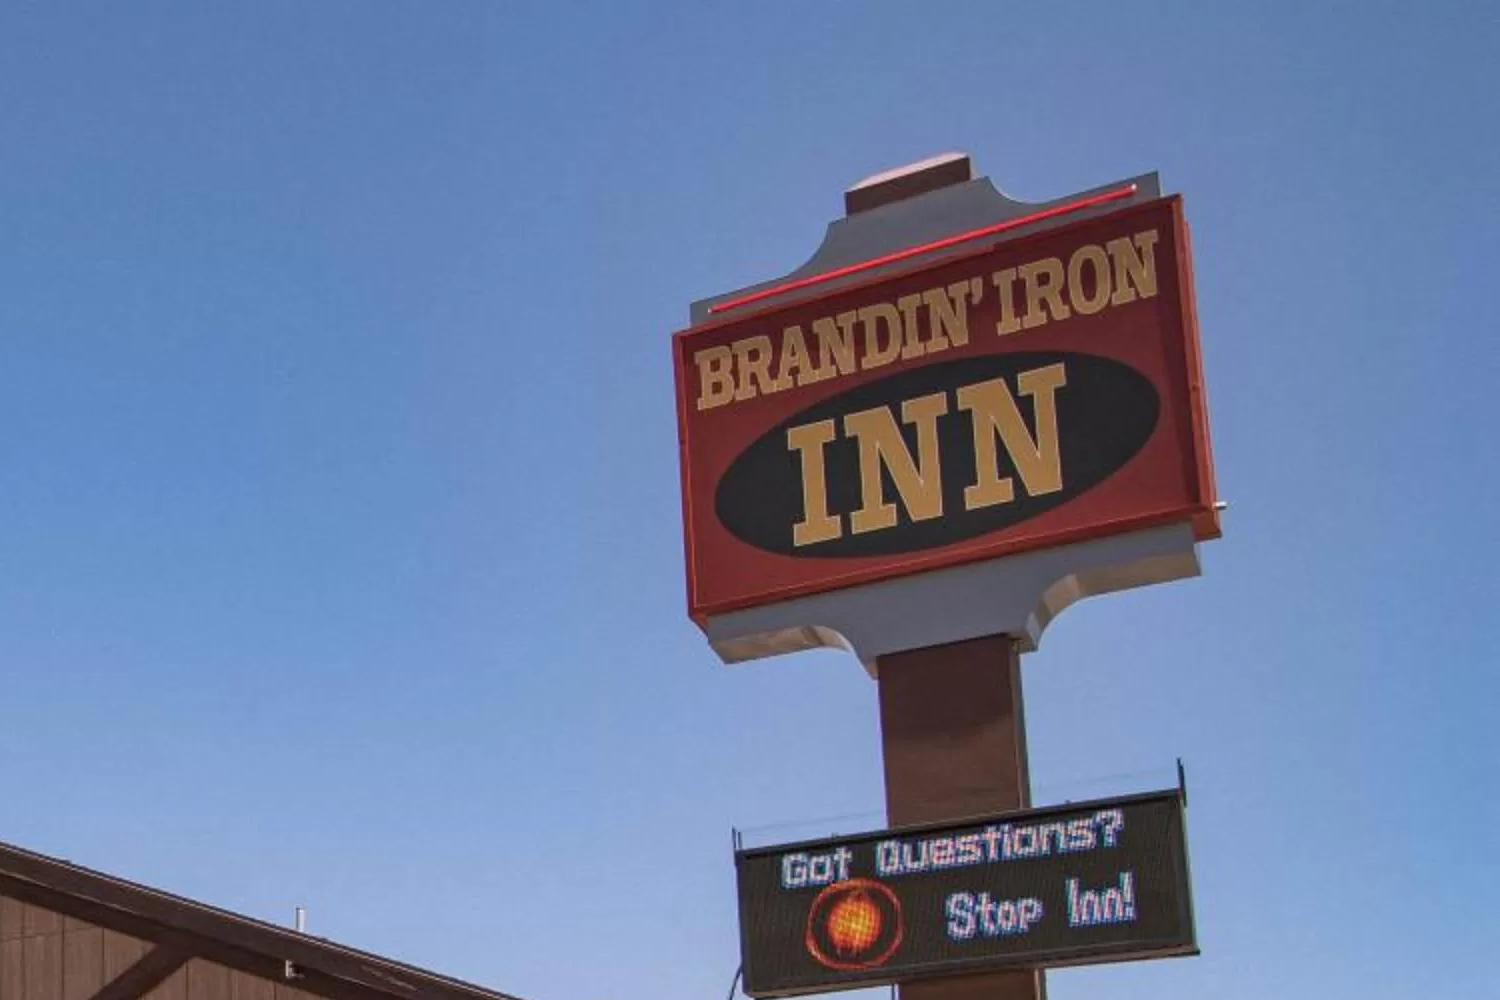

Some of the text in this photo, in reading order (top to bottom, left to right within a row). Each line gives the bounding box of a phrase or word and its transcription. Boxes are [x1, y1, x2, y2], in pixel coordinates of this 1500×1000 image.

[693, 229, 1159, 410] BRANDIN' IRON
[787, 363, 1066, 546] INN
[781, 808, 1124, 889] Got Questions?
[945, 871, 1136, 940] Stop Inn!
